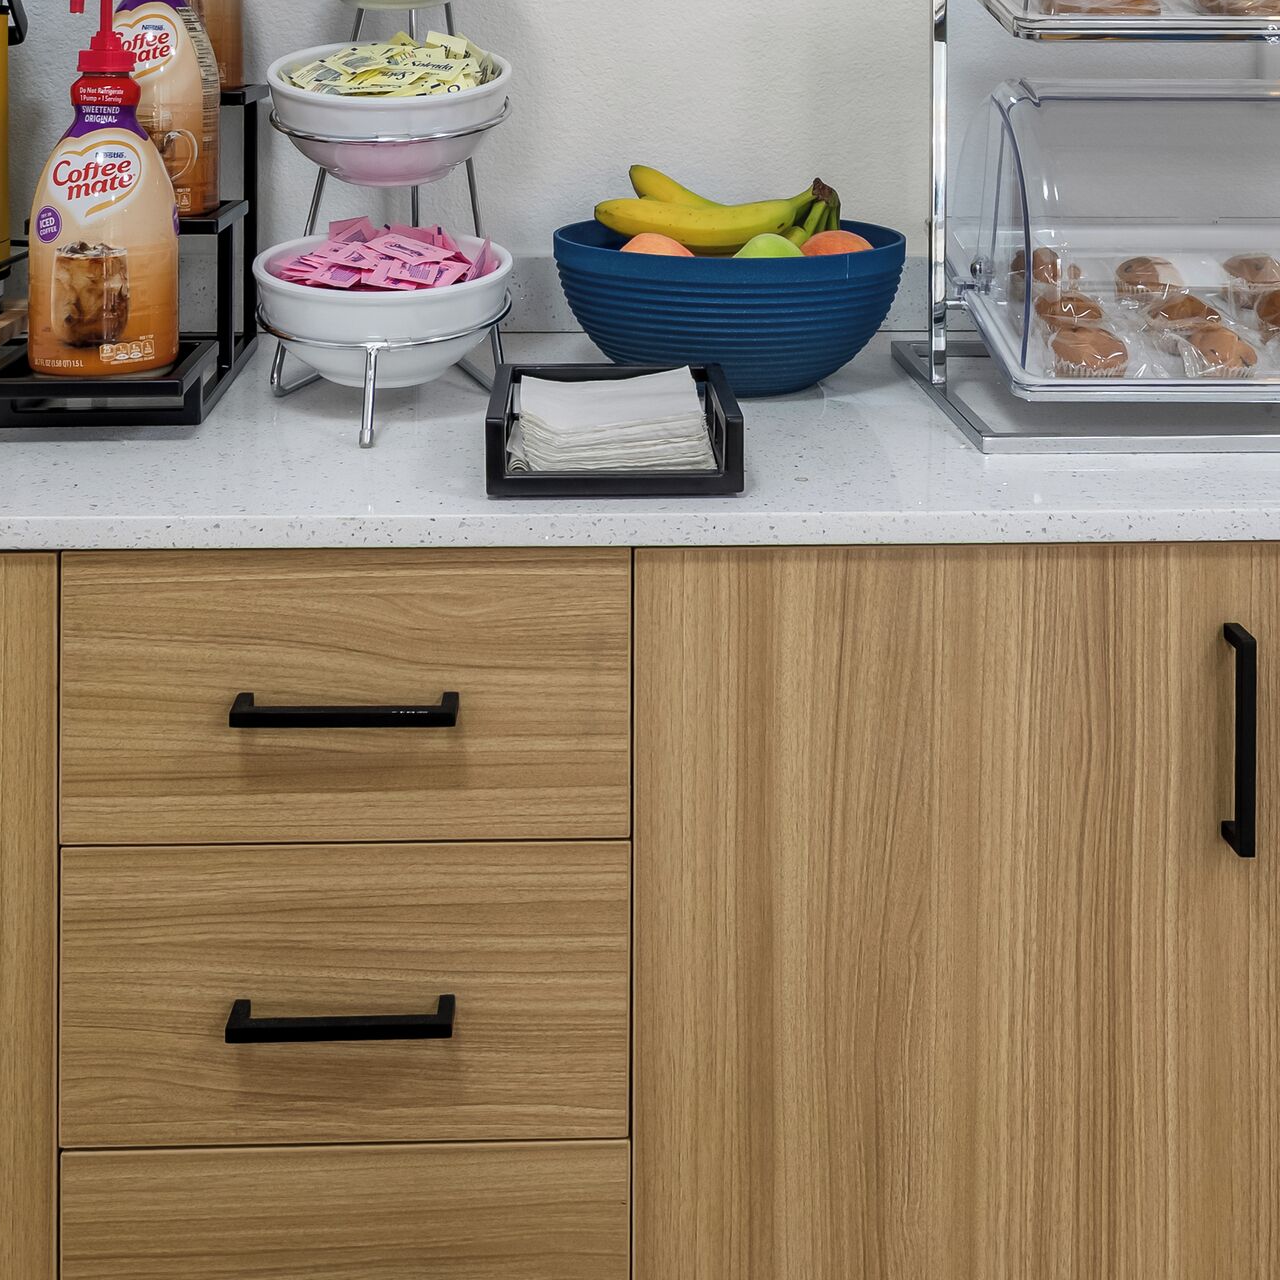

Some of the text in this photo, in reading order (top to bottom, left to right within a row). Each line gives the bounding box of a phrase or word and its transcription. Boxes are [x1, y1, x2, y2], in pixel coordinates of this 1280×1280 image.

[137, 44, 171, 63] ate
[80, 86, 86, 94] Do
[83, 94, 97, 102] Pump
[105, 94, 122, 104] Serving
[82, 105, 120, 114] SWEETENED
[84, 114, 117, 123] ORIGINAL
[52, 159, 132, 187] Coffee
[67, 173, 133, 200] mate
[39, 216, 55, 229] ICED
